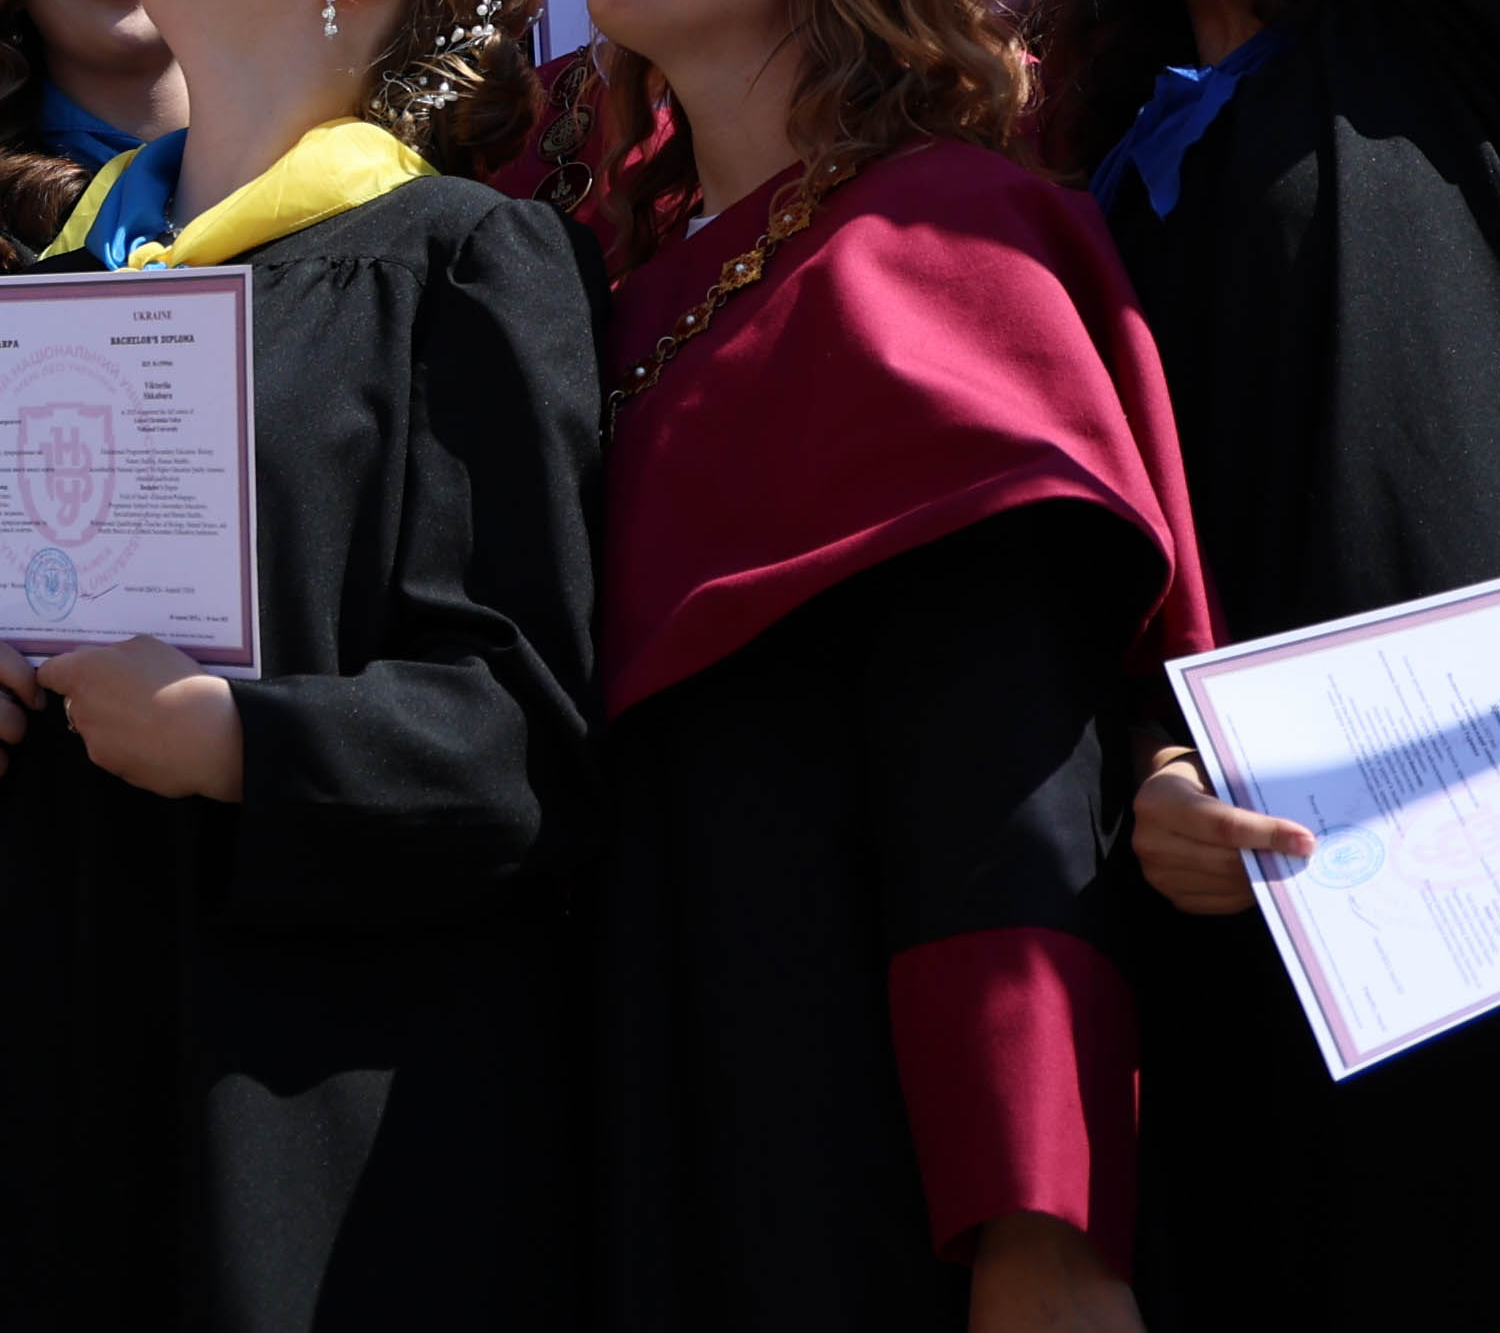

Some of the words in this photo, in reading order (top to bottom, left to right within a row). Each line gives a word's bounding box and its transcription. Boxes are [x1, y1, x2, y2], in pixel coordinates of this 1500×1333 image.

[132, 311, 172, 321] UKRAINE
[110, 336, 158, 346] BACHELOR'S
[160, 334, 195, 344] DIPLOMA
